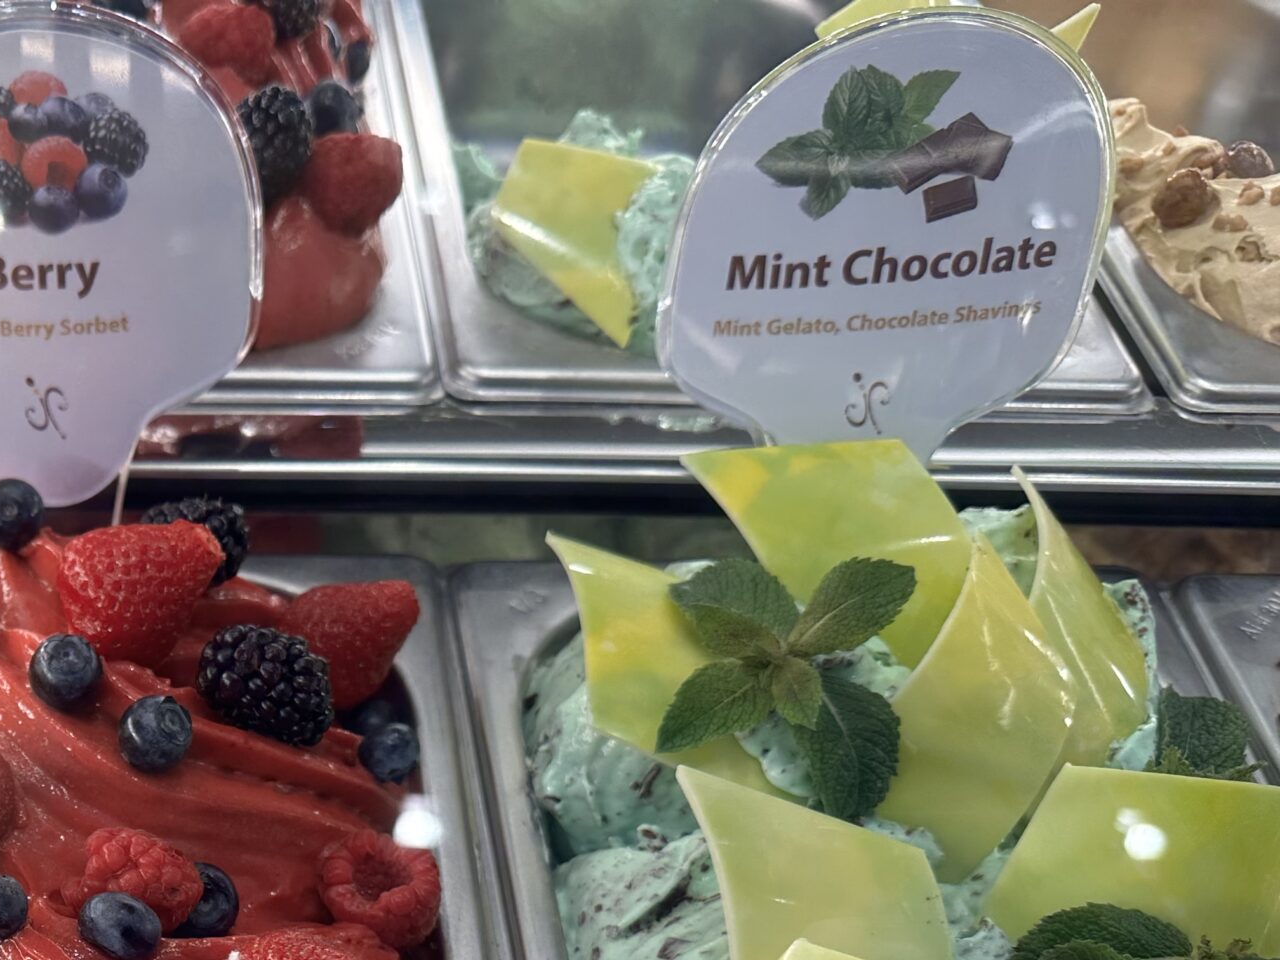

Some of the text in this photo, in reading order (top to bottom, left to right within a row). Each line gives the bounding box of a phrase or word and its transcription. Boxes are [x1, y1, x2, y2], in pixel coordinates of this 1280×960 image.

[725, 237, 1057, 290] Mint Chocolate
[0, 319, 54, 341] Berry
[59, 316, 130, 336] Sorbet
[713, 319, 762, 337] Mint
[766, 317, 840, 336] Gelato,
[846, 309, 949, 332] Chocolate
